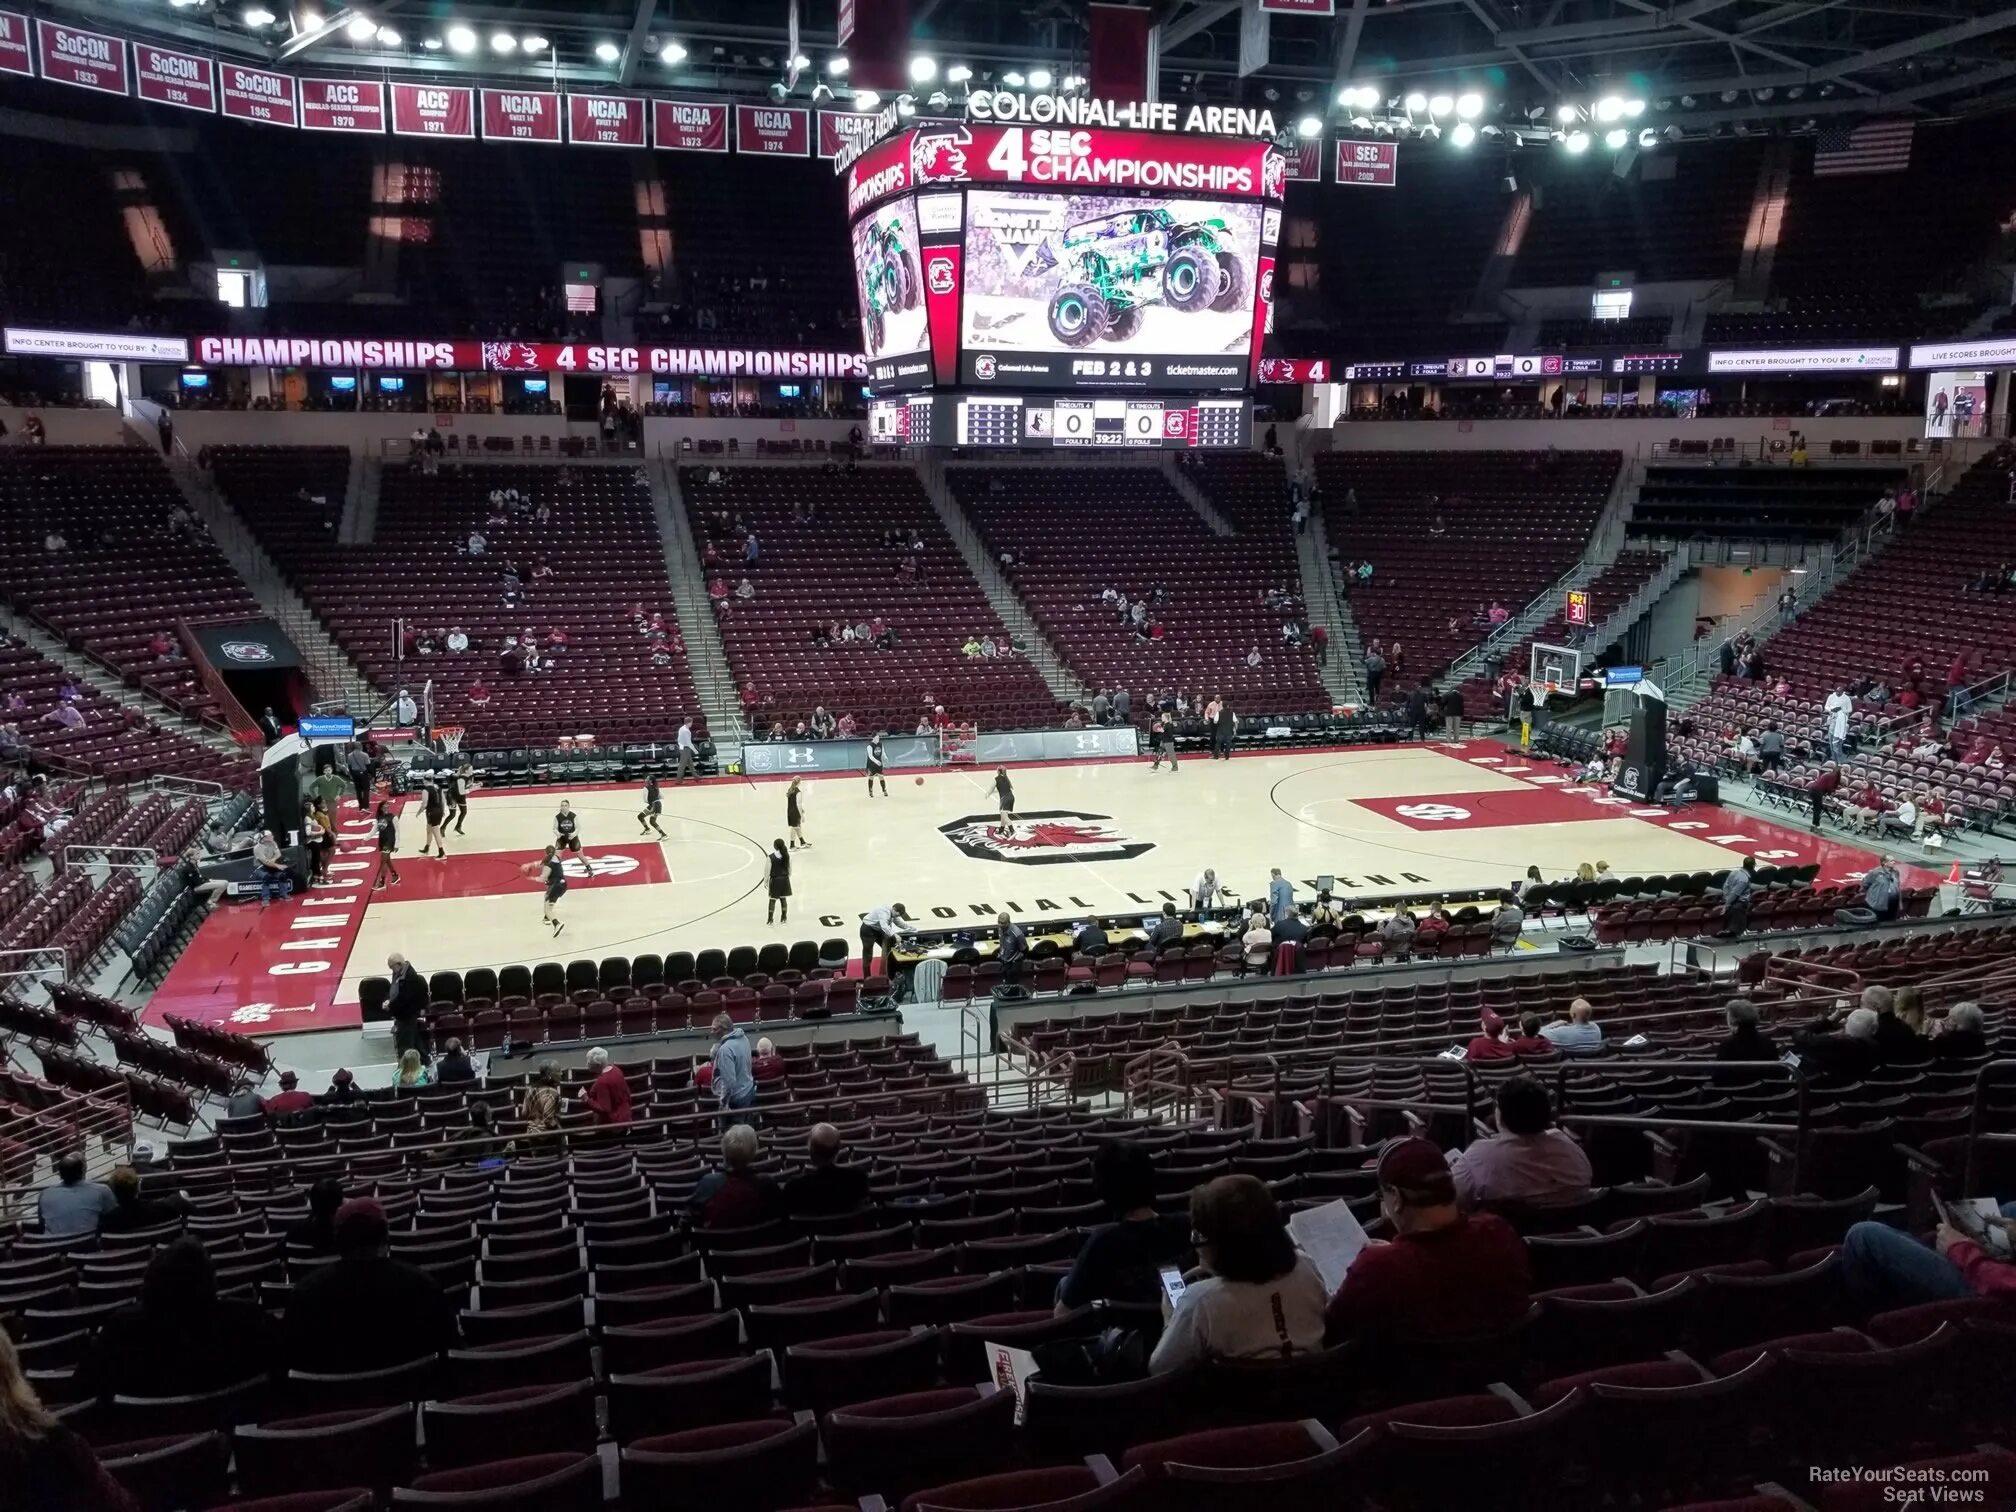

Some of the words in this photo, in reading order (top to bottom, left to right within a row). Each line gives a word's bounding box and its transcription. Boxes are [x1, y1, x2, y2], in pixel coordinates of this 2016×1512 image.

[56, 31, 109, 61] SoCON
[150, 52, 198, 79] SoCON
[74, 69, 97, 84] 1933
[235, 72, 281, 96] SoCON
[167, 89, 187, 102] 1934
[326, 85, 358, 103] ACC
[417, 91, 448, 109] ACC
[250, 106, 270, 118] 1945
[501, 95, 543, 114] NCAA
[588, 100, 628, 119] NCAA
[968, 90, 1120, 127] COLONIAL
[1129, 101, 1177, 131] LIFE
[1184, 105, 1277, 136] ARENA
[332, 116, 354, 126] 1970
[672, 106, 711, 125] NCAA
[754, 111, 792, 129] NCAA
[875, 101, 897, 142] ARENA
[424, 121, 444, 132] 1971
[512, 126, 532, 137] 1971
[598, 131, 619, 141] 1972
[681, 137, 702, 147] 1973
[1029, 129, 1092, 157] SEC
[763, 141, 783, 151] 1974
[987, 128, 1028, 181] 4
[1357, 146, 1378, 161] SEC
[1031, 155, 1252, 192] CHAMPIONSHIPS
[12, 338, 32, 346] INFO
[34, 339, 65, 348] CENTER
[67, 341, 104, 350] BROUGHT
[201, 338, 454, 368] CHAMPIONSHIPS
[1980, 348, 2016, 357] BROUGHT
[556, 346, 576, 371] 4
[587, 346, 639, 372] SEC
[651, 349, 868, 377] CHAMPIONSHIPS
[1073, 360, 1105, 375] FEB
[1109, 361, 1120, 375] 2
[1125, 361, 1137, 376] &
[1141, 361, 1152, 376] 3
[1167, 364, 1238, 376] ticketmaster.com
[1476, 361, 1486, 373] 0
[1522, 360, 1532, 372] 0
[1735, 358, 1766, 366] CENTER
[1308, 361, 1324, 382] 4
[1066, 414, 1081, 433] 0
[1138, 415, 1152, 433] 0
[1096, 434, 1122, 445] 39:22
[1572, 604, 1584, 619] 30
[819, 896, 1095, 928] CLONIAL
[1290, 872, 1432, 893] RENA
